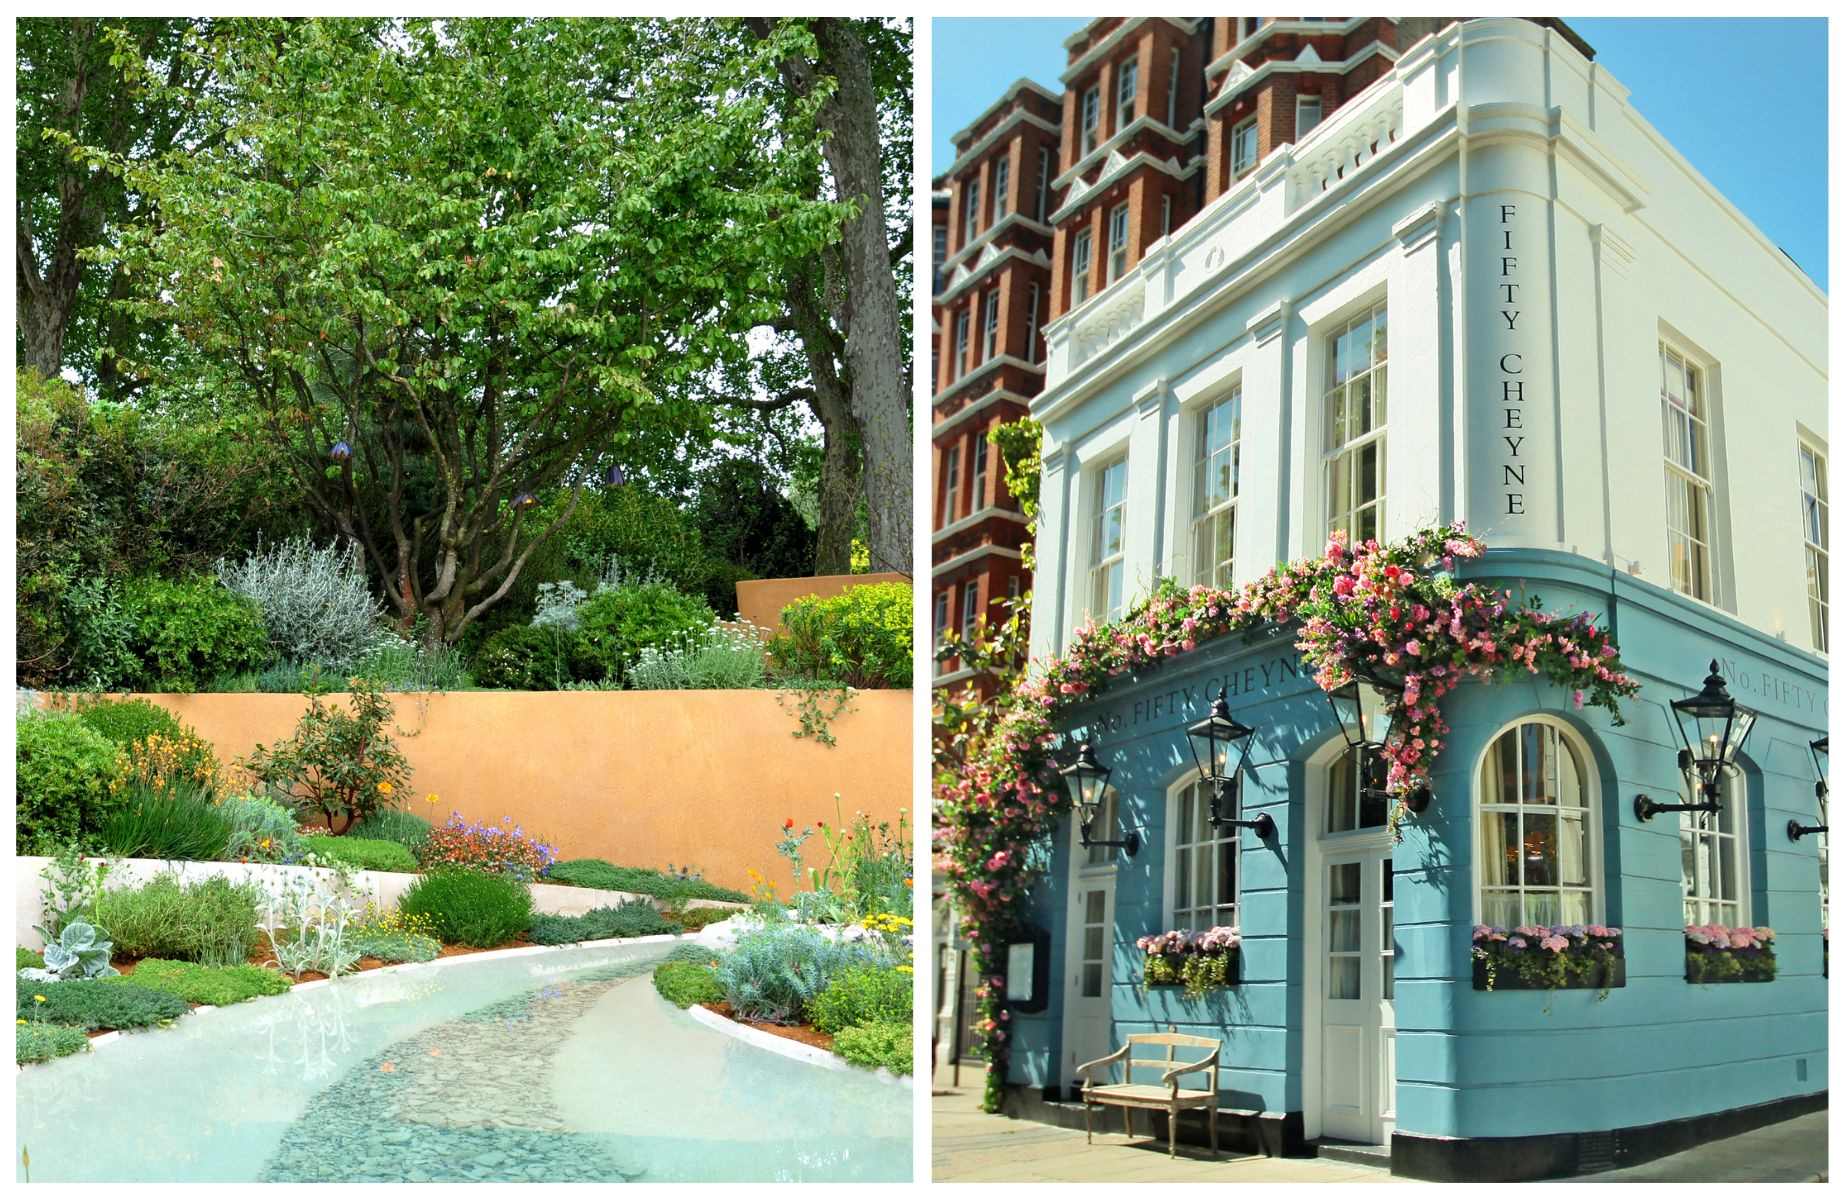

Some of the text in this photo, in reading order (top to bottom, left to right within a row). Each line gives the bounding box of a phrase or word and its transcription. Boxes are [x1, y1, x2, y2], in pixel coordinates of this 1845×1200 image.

[1500, 205, 1525, 515] FIFTY CHEYNE
[1133, 685, 1196, 725] FIFTY
[1721, 657, 1757, 693] No.
[1762, 673, 1816, 713] FIFTY
